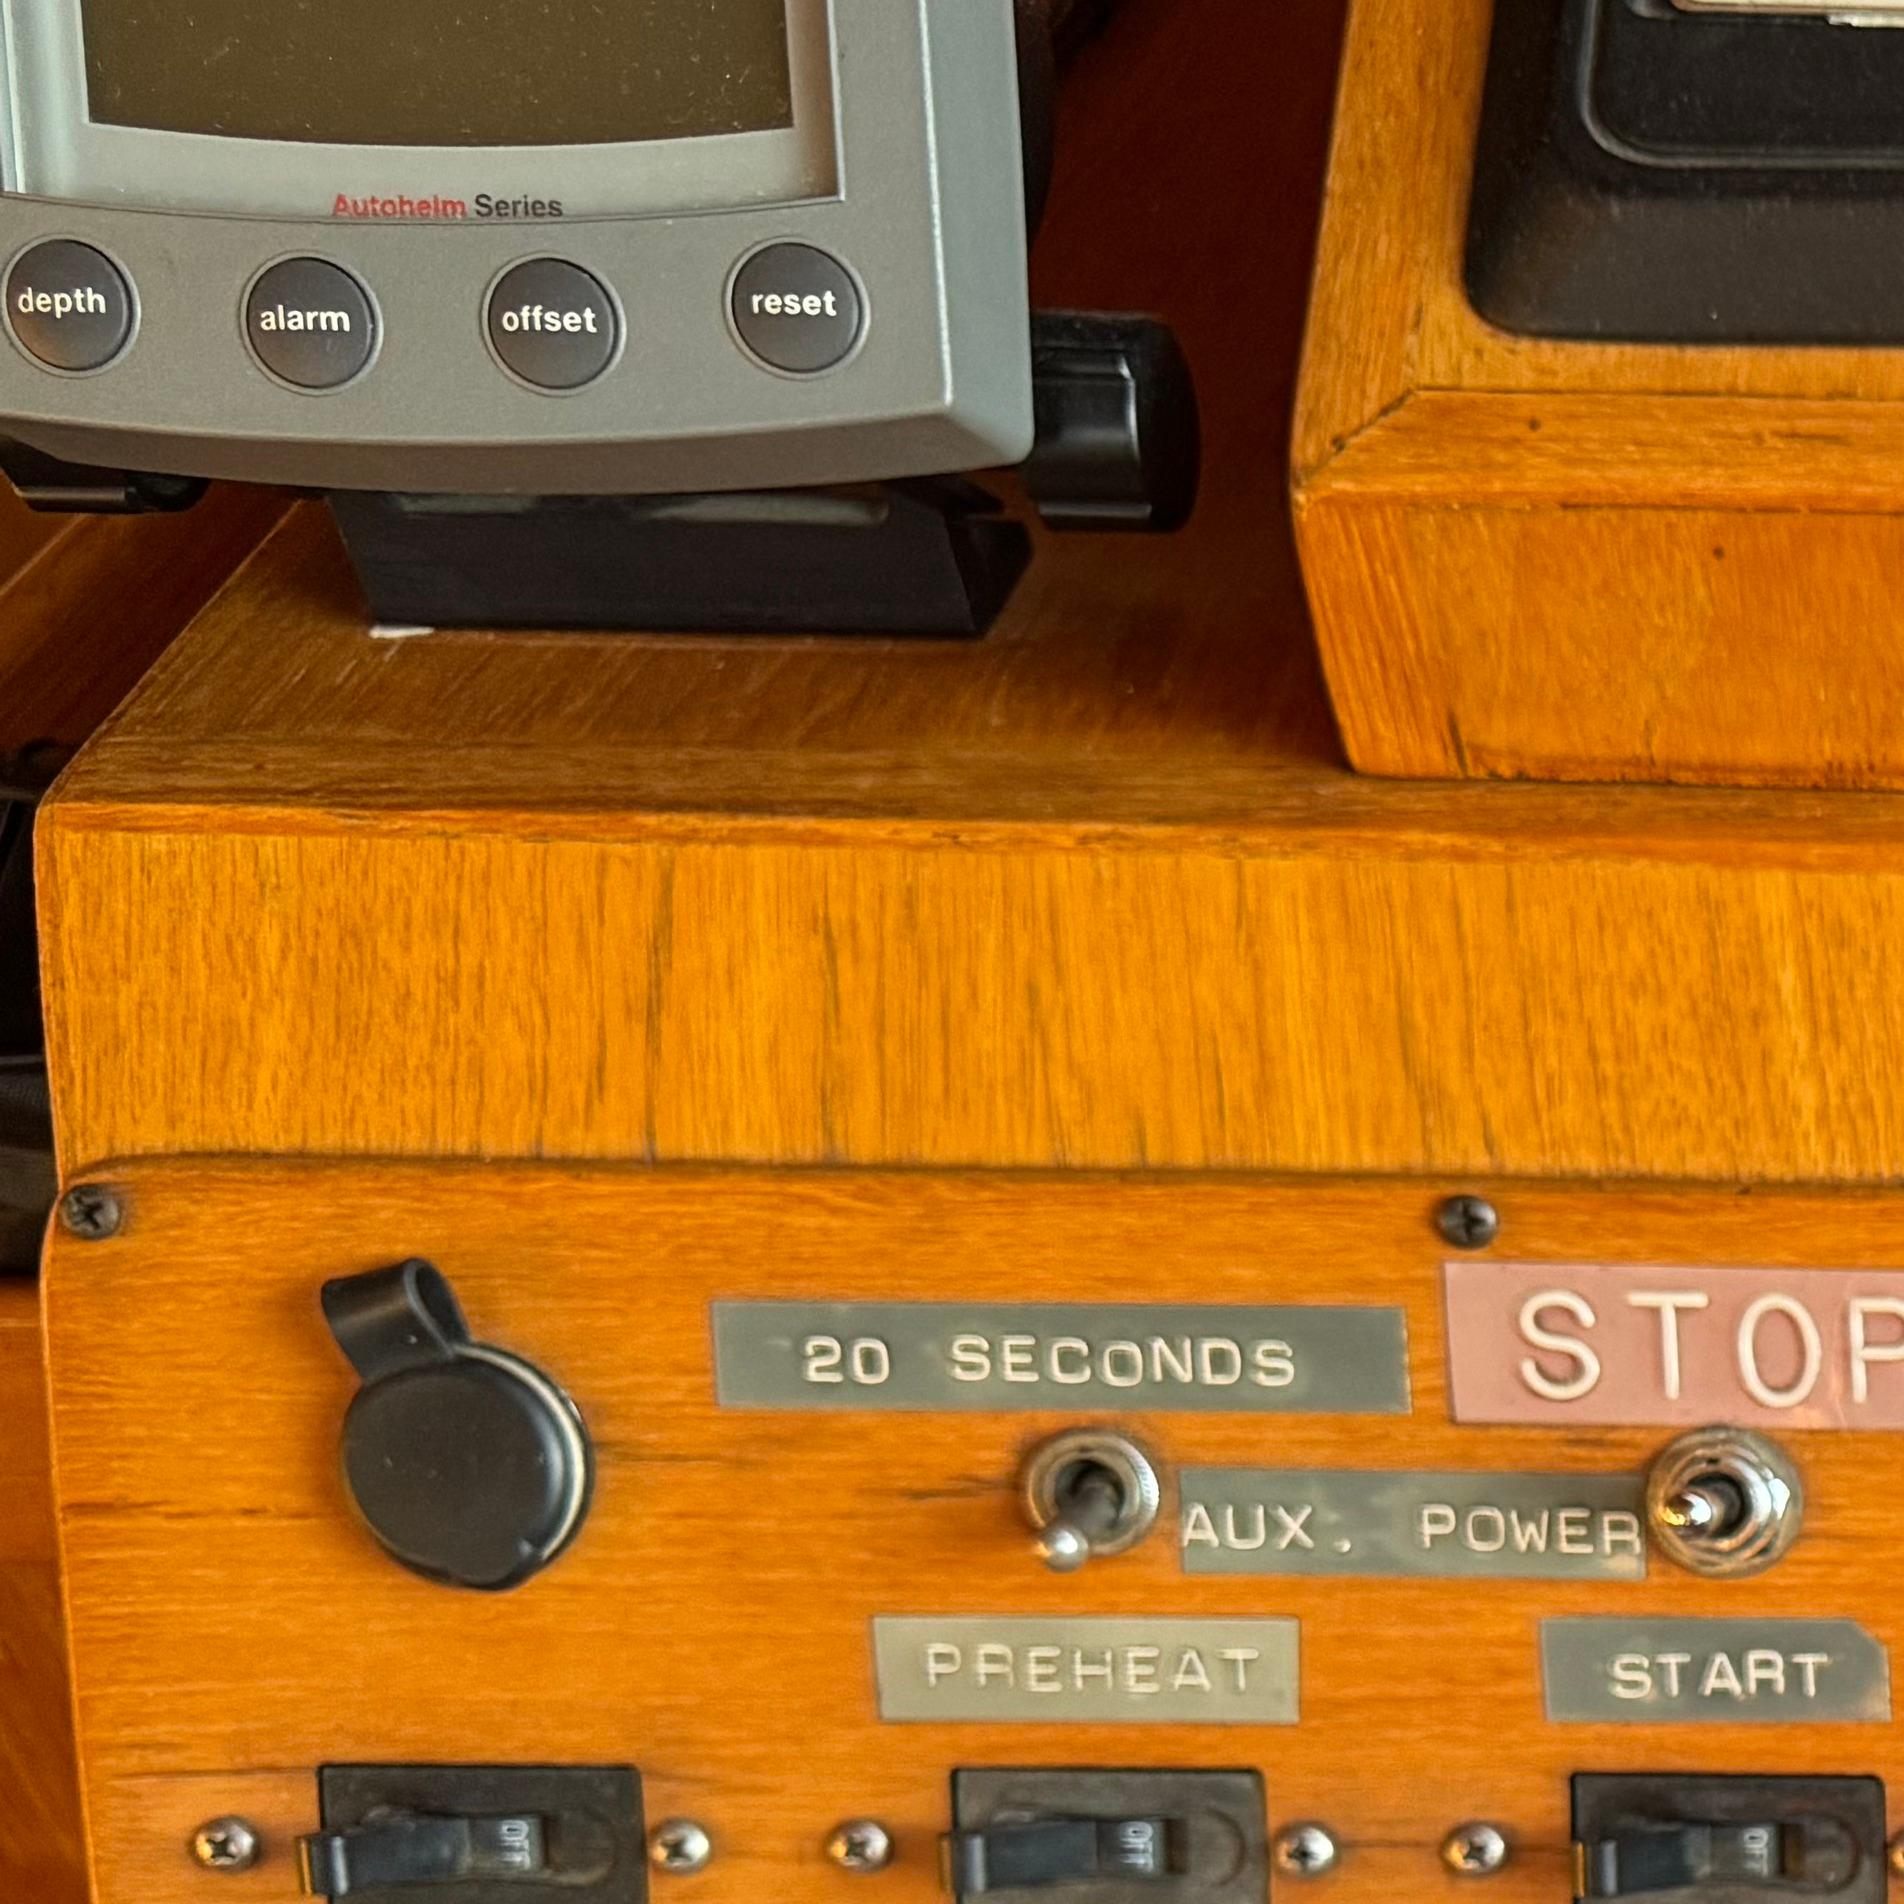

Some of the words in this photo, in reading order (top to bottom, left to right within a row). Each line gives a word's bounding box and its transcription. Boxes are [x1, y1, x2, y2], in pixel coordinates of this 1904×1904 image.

[332, 194, 467, 219] Autohelm
[474, 194, 563, 220] Series
[17, 286, 106, 318] depth
[751, 289, 837, 316] reset
[259, 305, 350, 333] alarm
[502, 305, 597, 334] offset
[804, 1336, 891, 1384] 20
[950, 1335, 1296, 1389] SECONDS
[1179, 1503, 1355, 1553] AUX.
[1418, 1505, 1644, 1557] POWER
[924, 1643, 1260, 1695] PREHEAT
[1608, 1651, 1830, 1700] START
